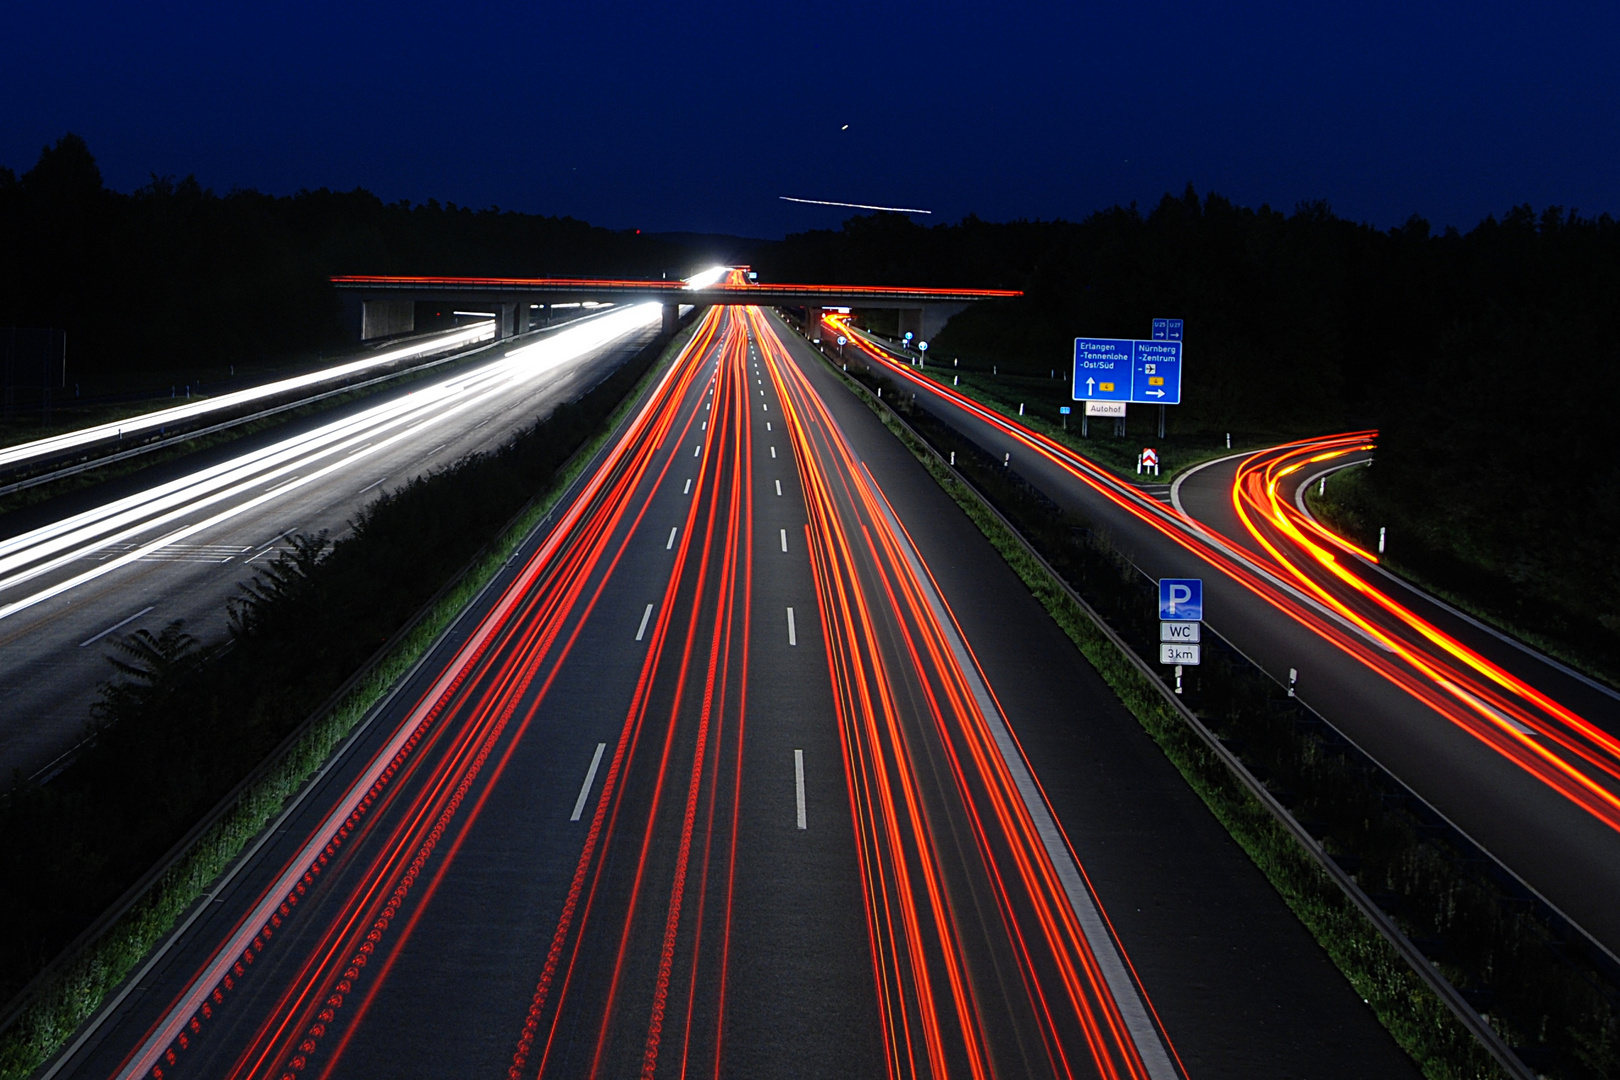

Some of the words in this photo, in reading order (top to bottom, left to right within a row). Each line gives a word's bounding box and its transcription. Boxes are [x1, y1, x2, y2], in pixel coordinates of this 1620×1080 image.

[1080, 342, 1116, 351] Erlangen
[1138, 344, 1176, 354] Nürnberg
[1080, 352, 1128, 360] -Tennenlohe
[1138, 354, 1176, 362] -Zentrum
[1169, 584, 1192, 614] P
[1170, 626, 1191, 637] WC
